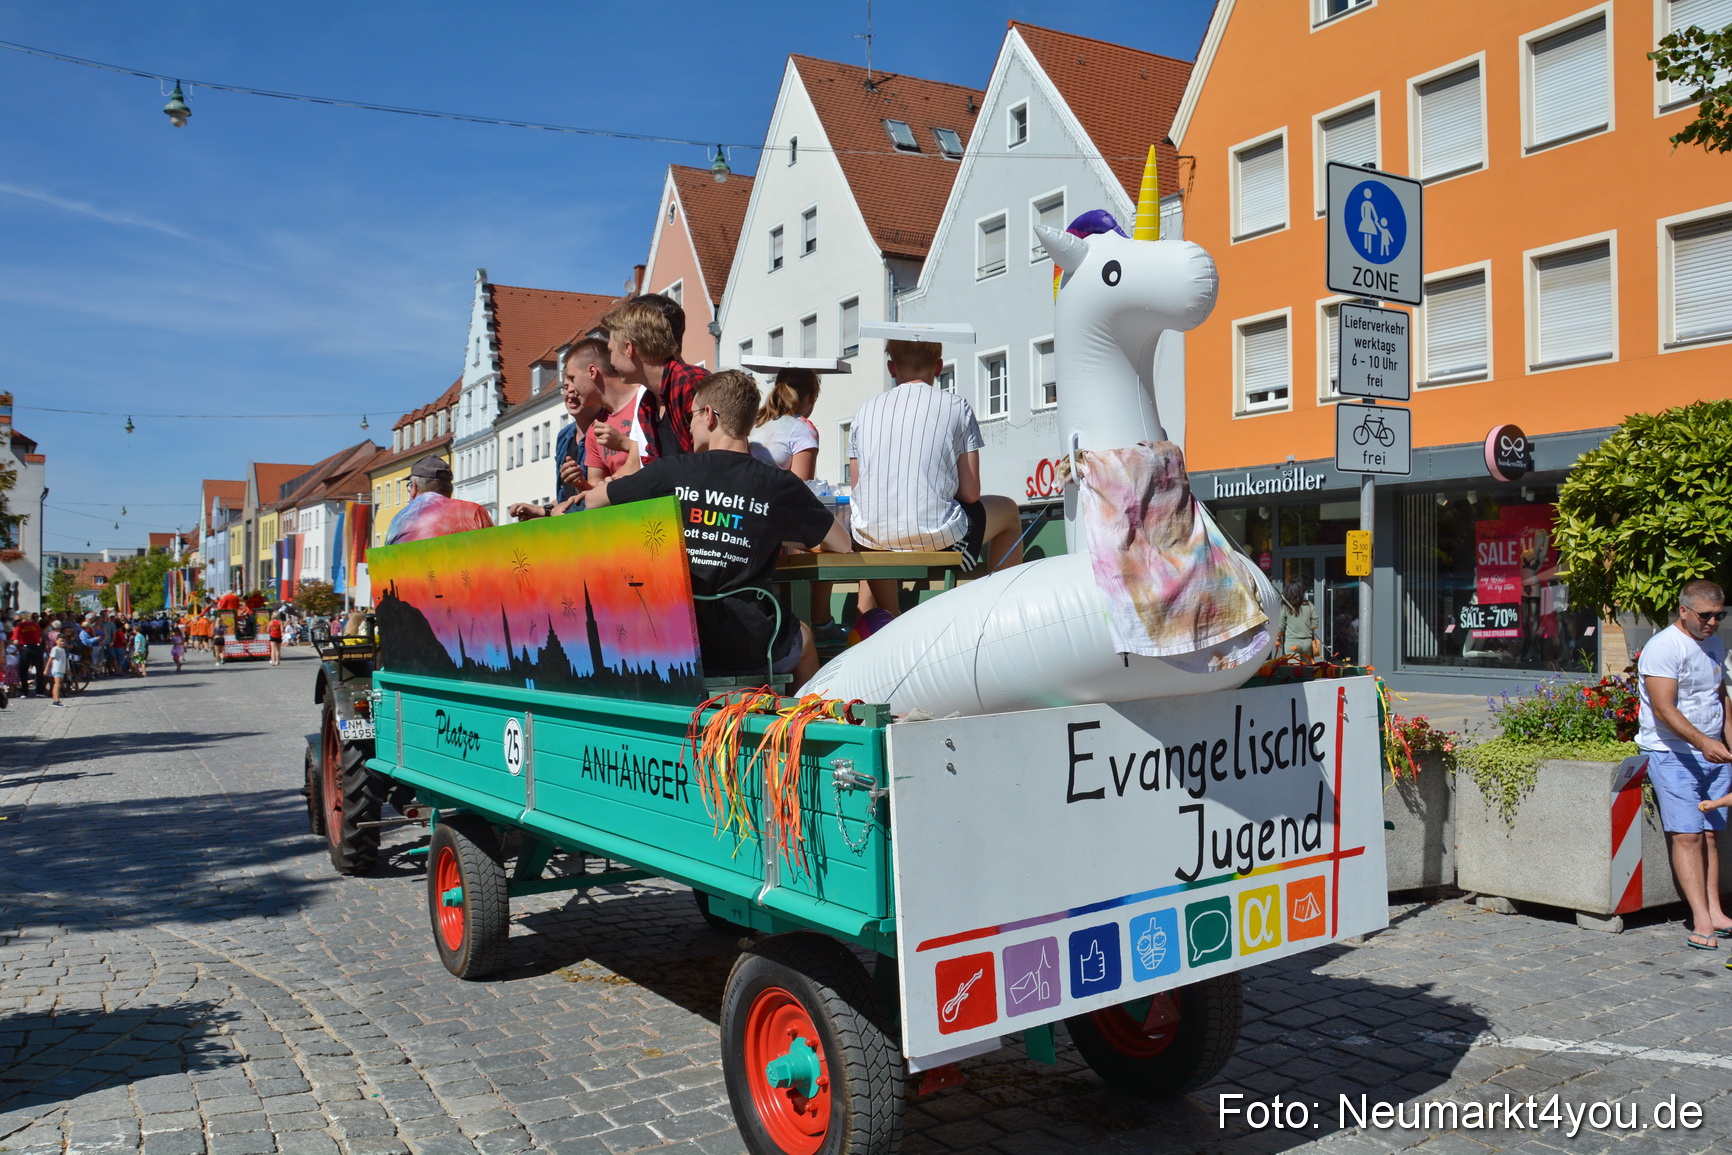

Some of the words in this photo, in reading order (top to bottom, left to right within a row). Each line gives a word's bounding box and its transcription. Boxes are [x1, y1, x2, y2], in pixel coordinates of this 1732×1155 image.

[1352, 265, 1399, 293] ZONE
[1344, 314, 1405, 336] Lieferverkehr
[1354, 337, 1396, 355] werktags
[1351, 353, 1358, 366] 6
[1368, 355, 1380, 369] 10
[1382, 356, 1398, 371] Uhr
[1366, 373, 1383, 388] frei
[1362, 450, 1386, 466] frei
[1213, 467, 1325, 499] hunkemöller
[674, 486, 700, 502] Die
[705, 489, 745, 510] Welt
[748, 497, 770, 516] ist
[689, 507, 744, 531] BUNT.
[683, 528, 700, 539] ott
[701, 531, 719, 541] sei
[721, 532, 751, 548] Dank.
[1352, 540, 1359, 550] S
[686, 547, 722, 558] ngelische
[722, 552, 749, 564] Jugend
[691, 556, 728, 568] Neumarkt
[1478, 541, 1518, 566] SALE
[1460, 612, 1485, 629] SALE
[348, 720, 363, 730] NM
[435, 708, 481, 761] Platzer
[507, 728, 520, 766] 25
[1066, 697, 1326, 804] Evangelische
[581, 743, 689, 804] ANHÄNGER
[1174, 780, 1324, 883] Jugend
